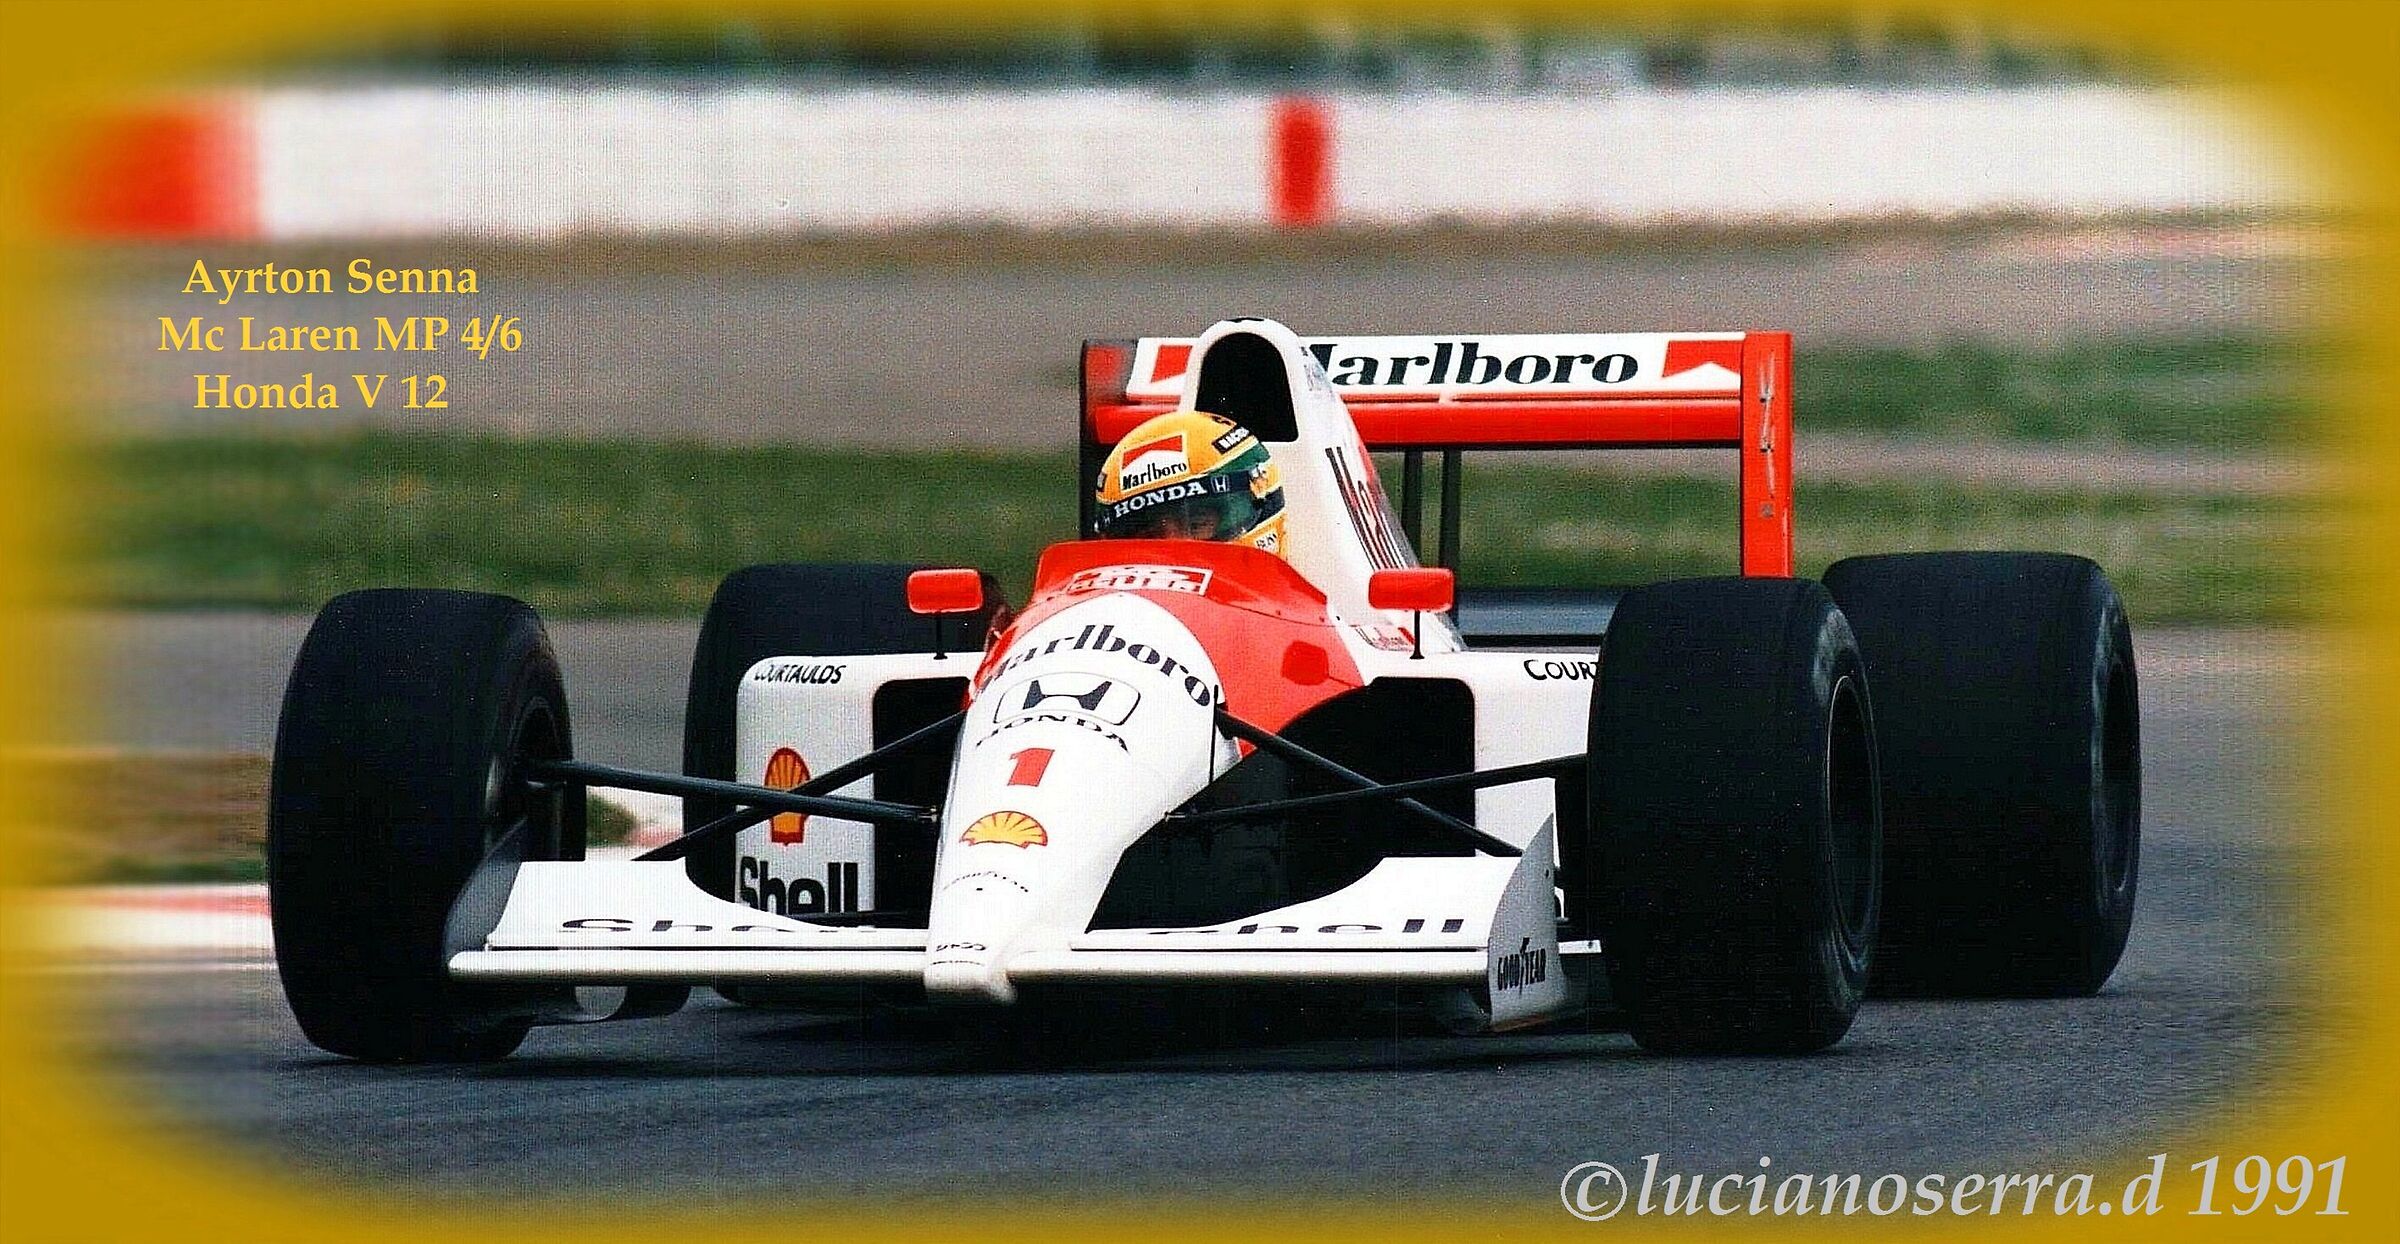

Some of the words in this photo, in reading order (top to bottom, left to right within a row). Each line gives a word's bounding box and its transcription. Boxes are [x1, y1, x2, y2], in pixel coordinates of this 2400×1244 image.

[1122, 462, 1187, 491] Marlboro
[1114, 481, 1208, 519] HONDA
[1008, 747, 1055, 788] 1
[740, 856, 858, 915] Shell
